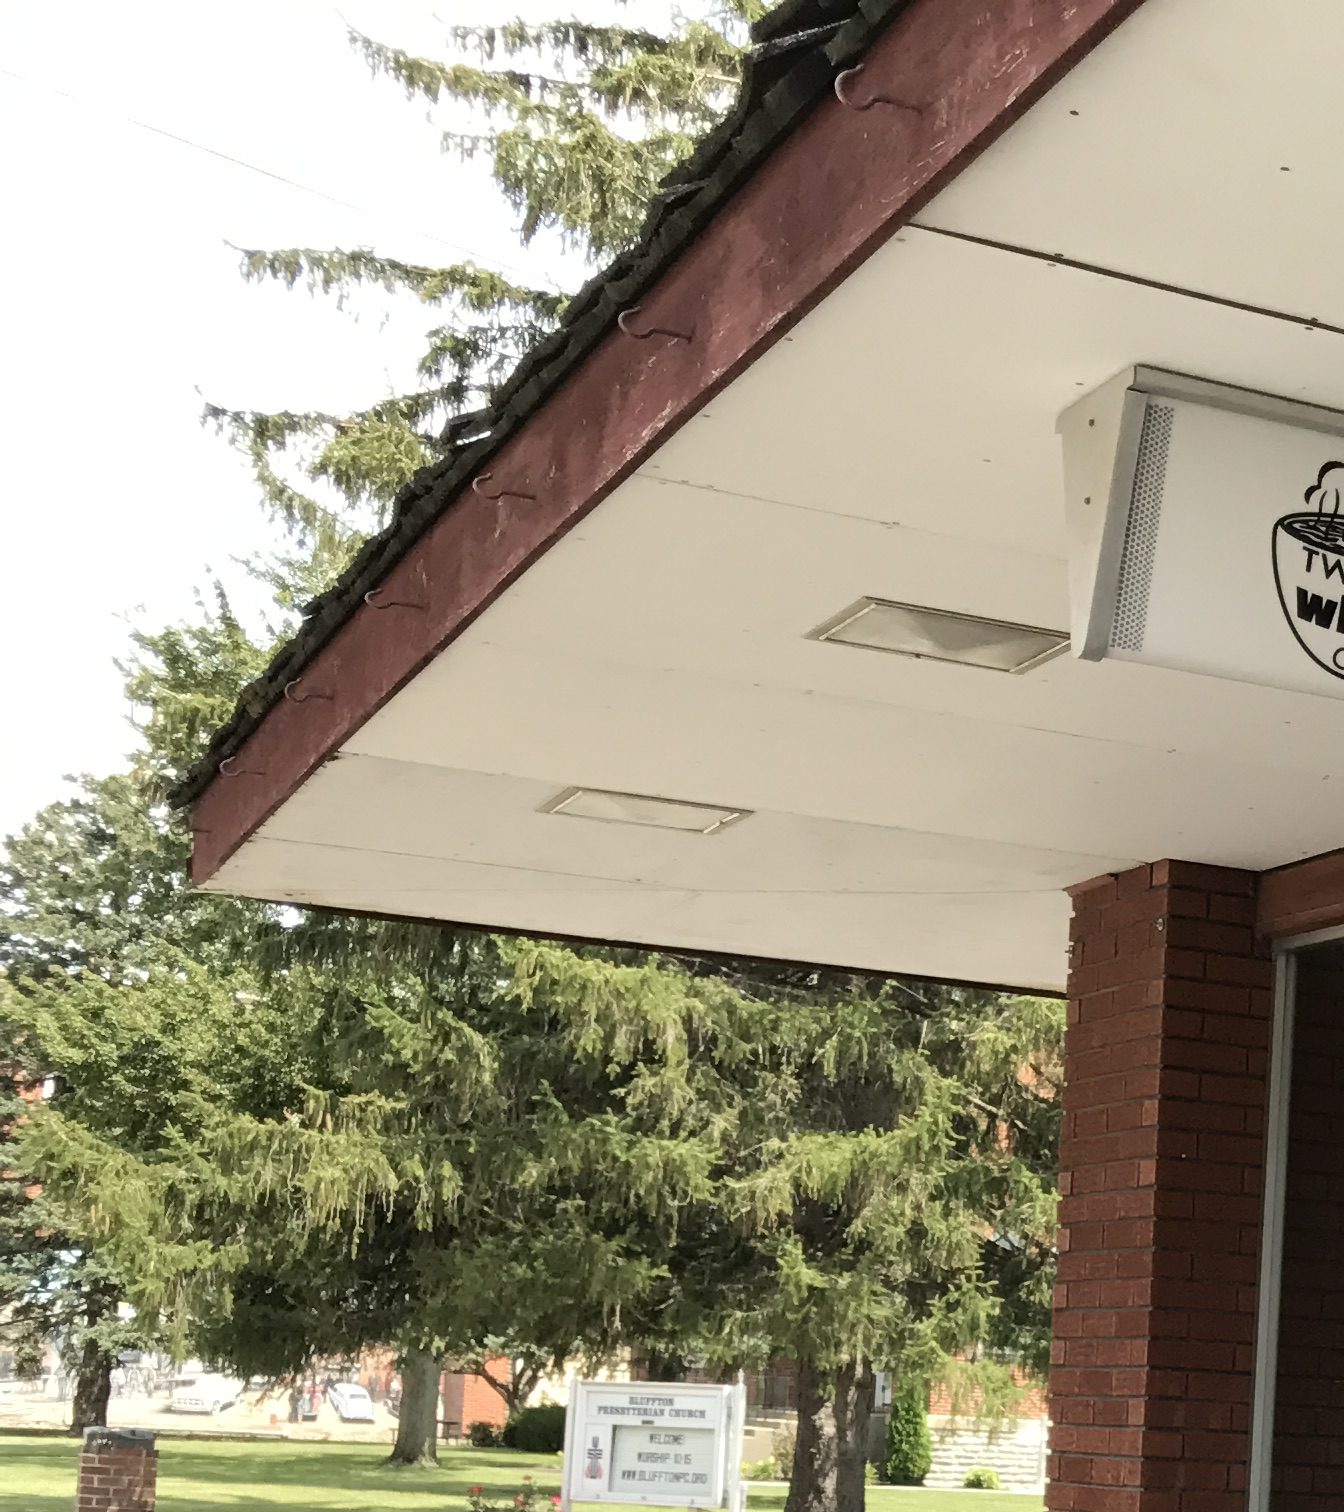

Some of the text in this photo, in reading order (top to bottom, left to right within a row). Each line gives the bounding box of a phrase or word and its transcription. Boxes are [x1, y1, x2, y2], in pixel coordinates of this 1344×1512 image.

[629, 1397, 674, 1406] BLUFFTON
[598, 1406, 706, 1418] PRESBYTERIAN CHURCH
